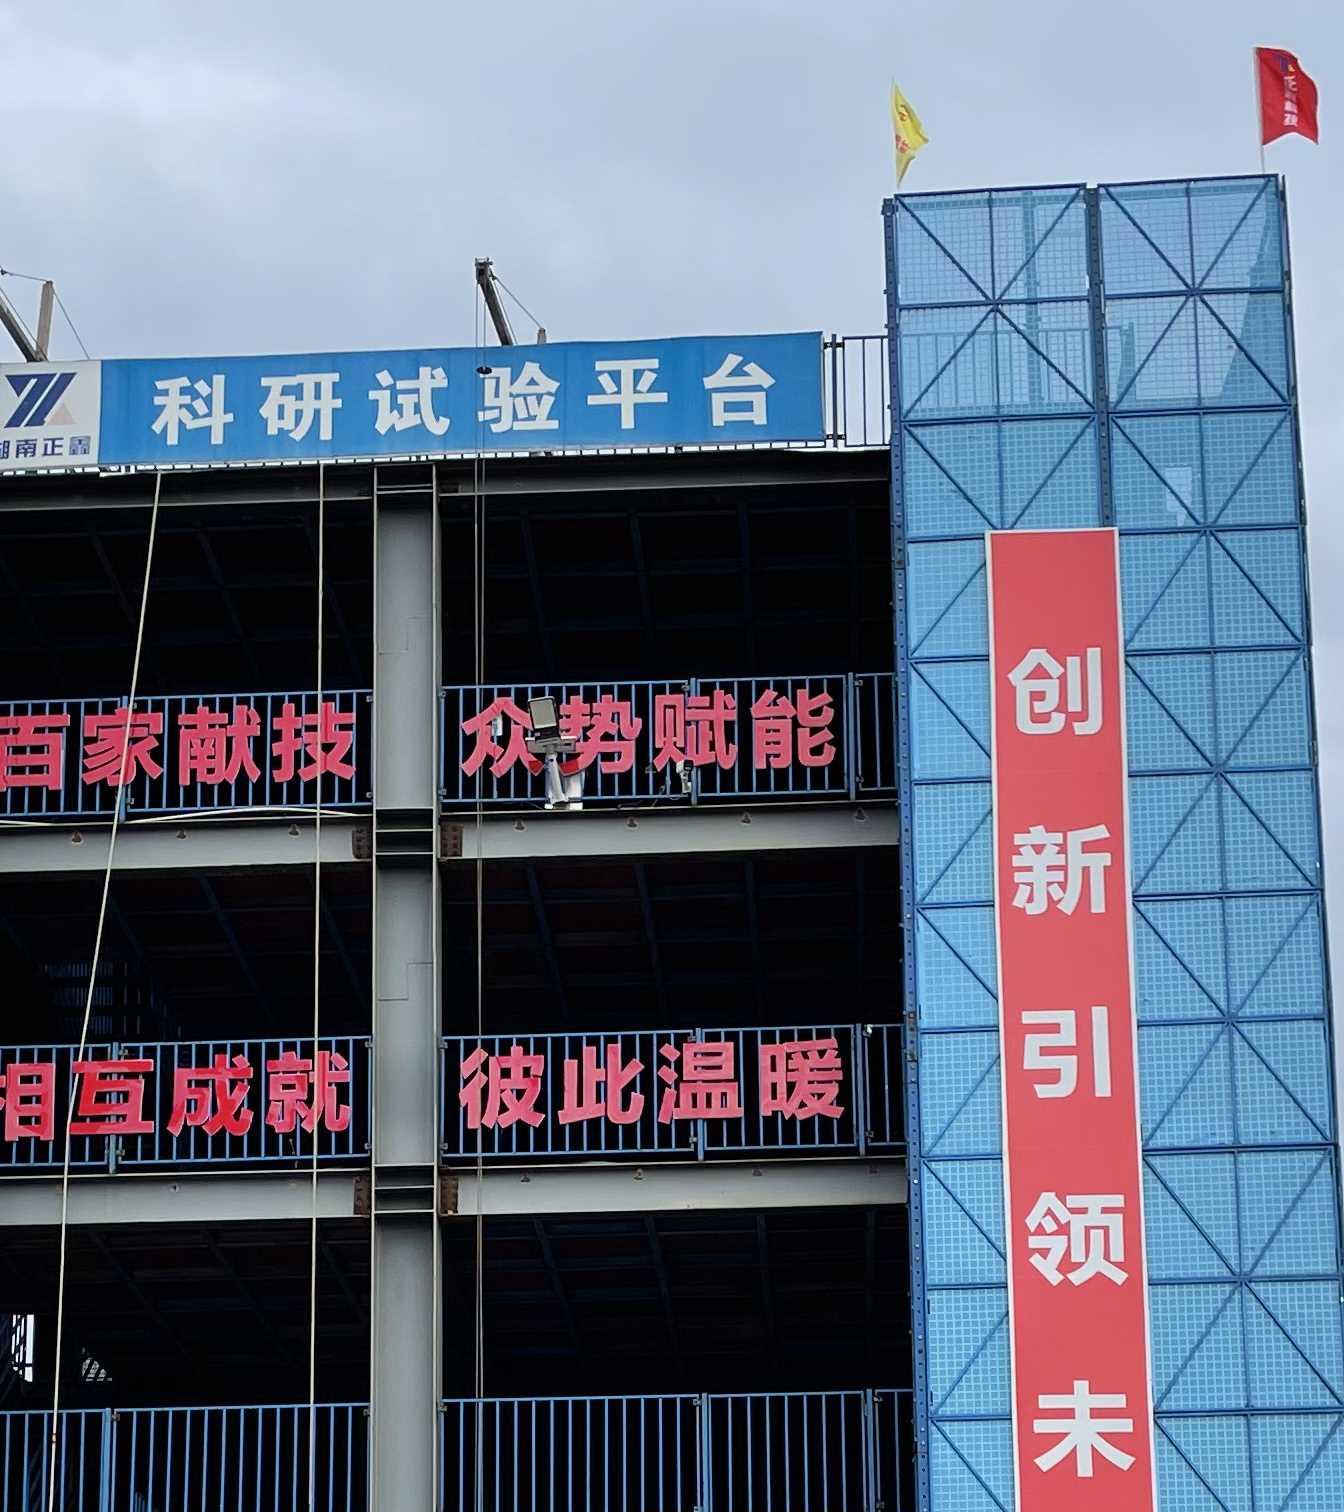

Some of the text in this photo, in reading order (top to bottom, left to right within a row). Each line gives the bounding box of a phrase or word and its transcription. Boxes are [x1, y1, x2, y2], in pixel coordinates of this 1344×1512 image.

[152, 352, 776, 446] 科研试验平台
[460, 687, 838, 777] 众势赋能
[458, 1036, 844, 1131] 彼此温暖
